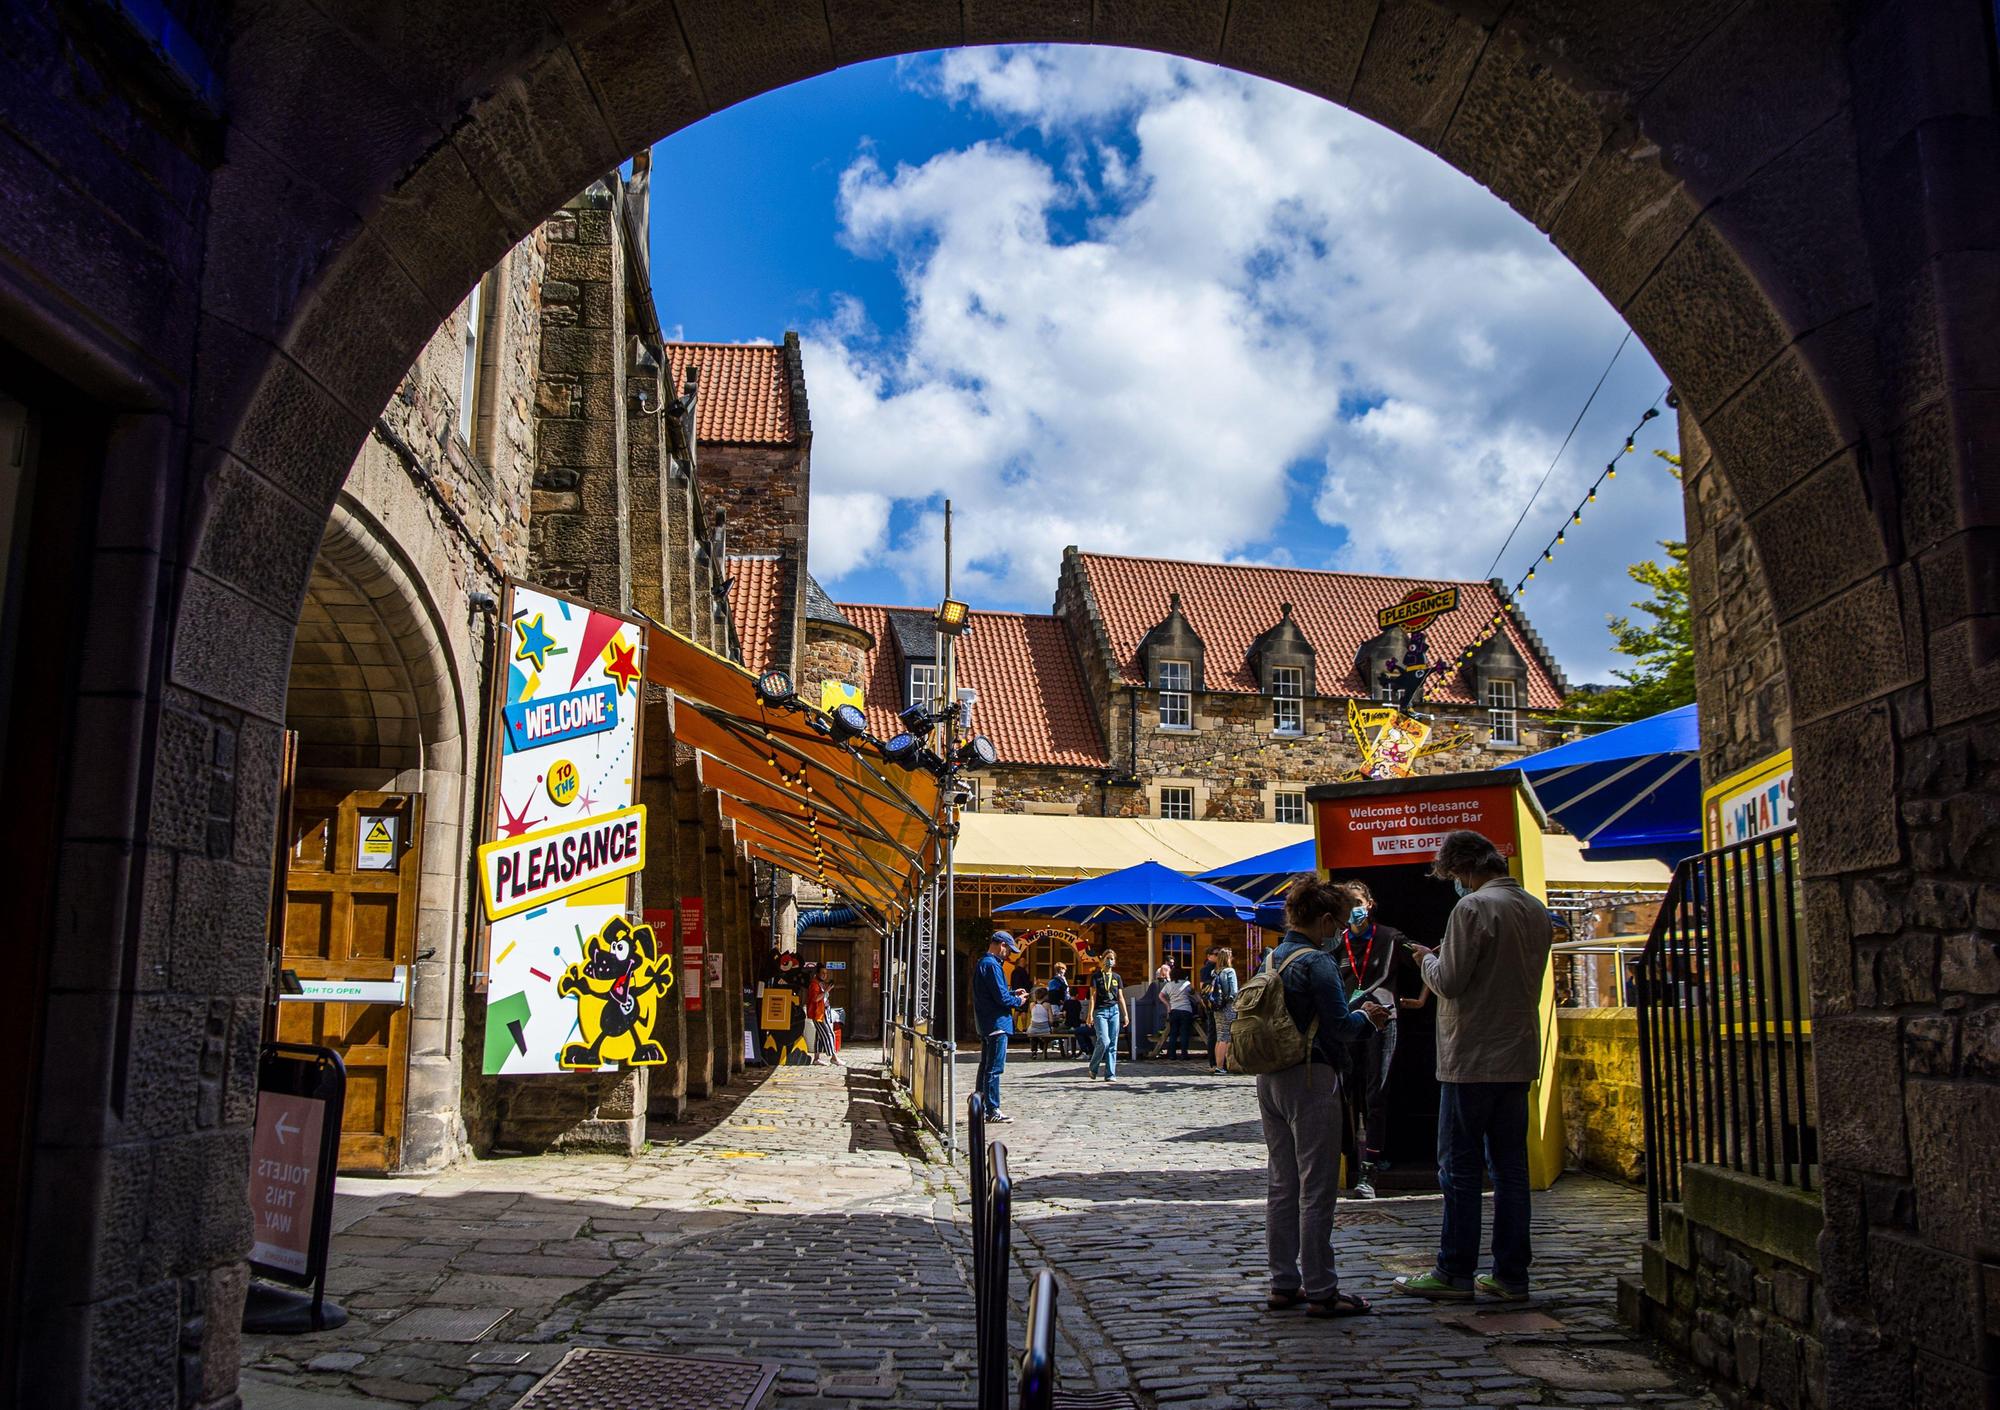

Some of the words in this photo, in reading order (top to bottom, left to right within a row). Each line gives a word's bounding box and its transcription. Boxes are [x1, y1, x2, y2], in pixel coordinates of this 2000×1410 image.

[1385, 594, 1450, 624] PLEASANCE
[525, 692, 606, 740] WELCOME
[556, 763, 572, 780] TO
[554, 775, 575, 797] THE
[1350, 806, 1402, 818] Welcome
[1405, 805, 1417, 815] to
[1419, 800, 1479, 813] Pleasance
[1348, 817, 1407, 831] Courtyard
[1410, 814, 1460, 827] Outdoor
[1462, 812, 1483, 823] Bar
[1377, 836, 1415, 851] WE'RE
[1417, 837, 1445, 848] OPE
[496, 821, 638, 903] PLEASANCE
[321, 987, 334, 995] TO
